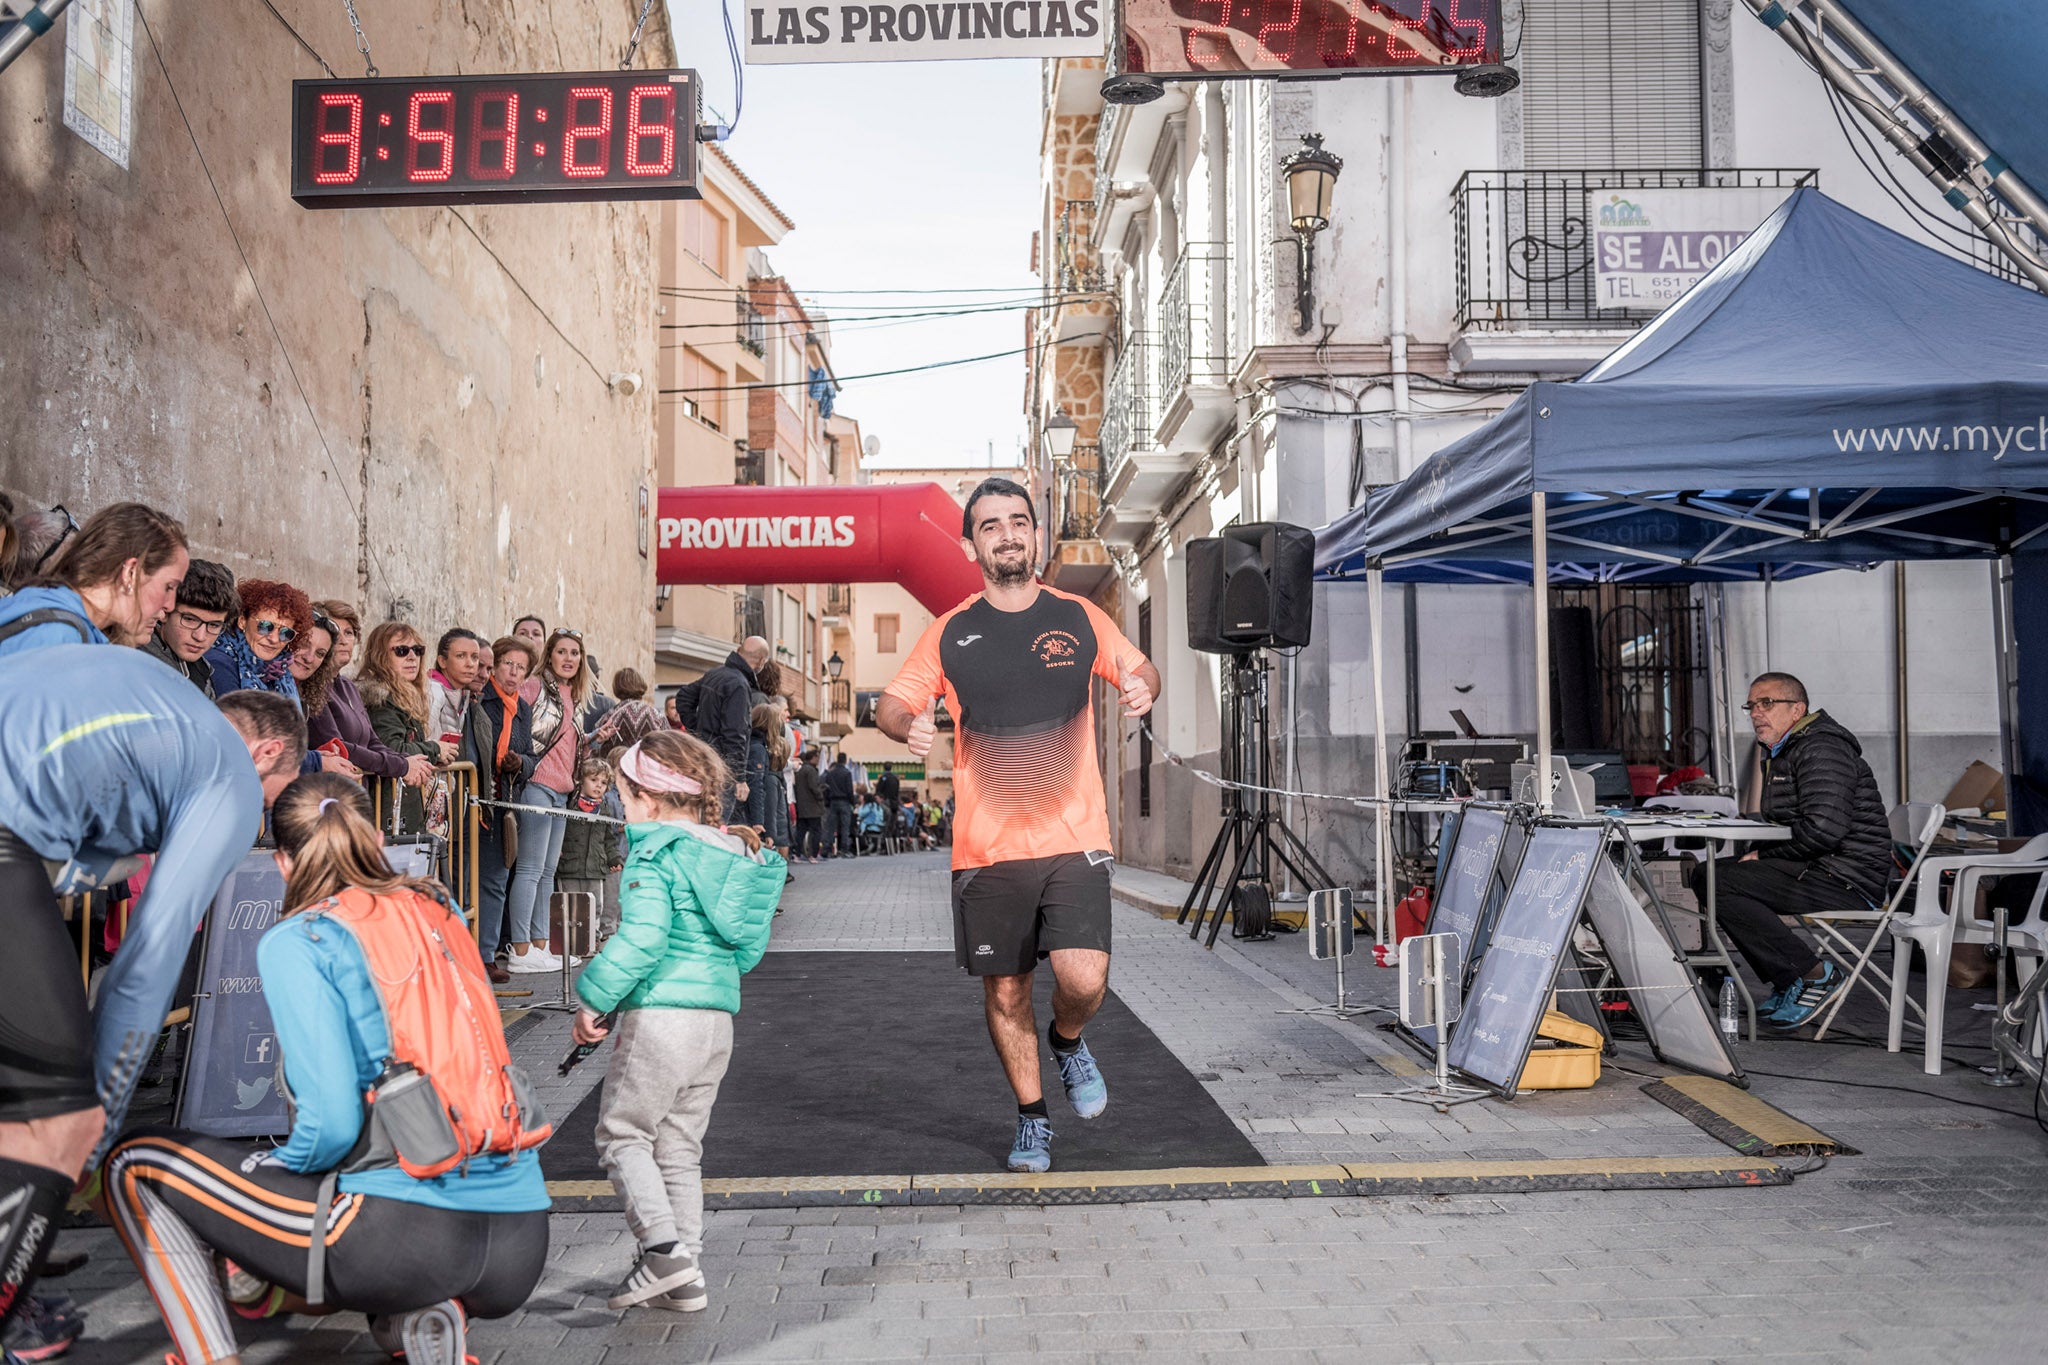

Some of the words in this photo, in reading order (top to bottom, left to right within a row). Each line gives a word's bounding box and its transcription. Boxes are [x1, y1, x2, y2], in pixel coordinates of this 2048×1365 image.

[751, 6, 830, 45] LAS
[841, 0, 1099, 43] PROVINCIAS
[315, 85, 676, 183] 3:51:26
[1603, 236, 1643, 270] SE
[1652, 277, 1681, 287] 651
[659, 516, 855, 549] PROVINCIAS
